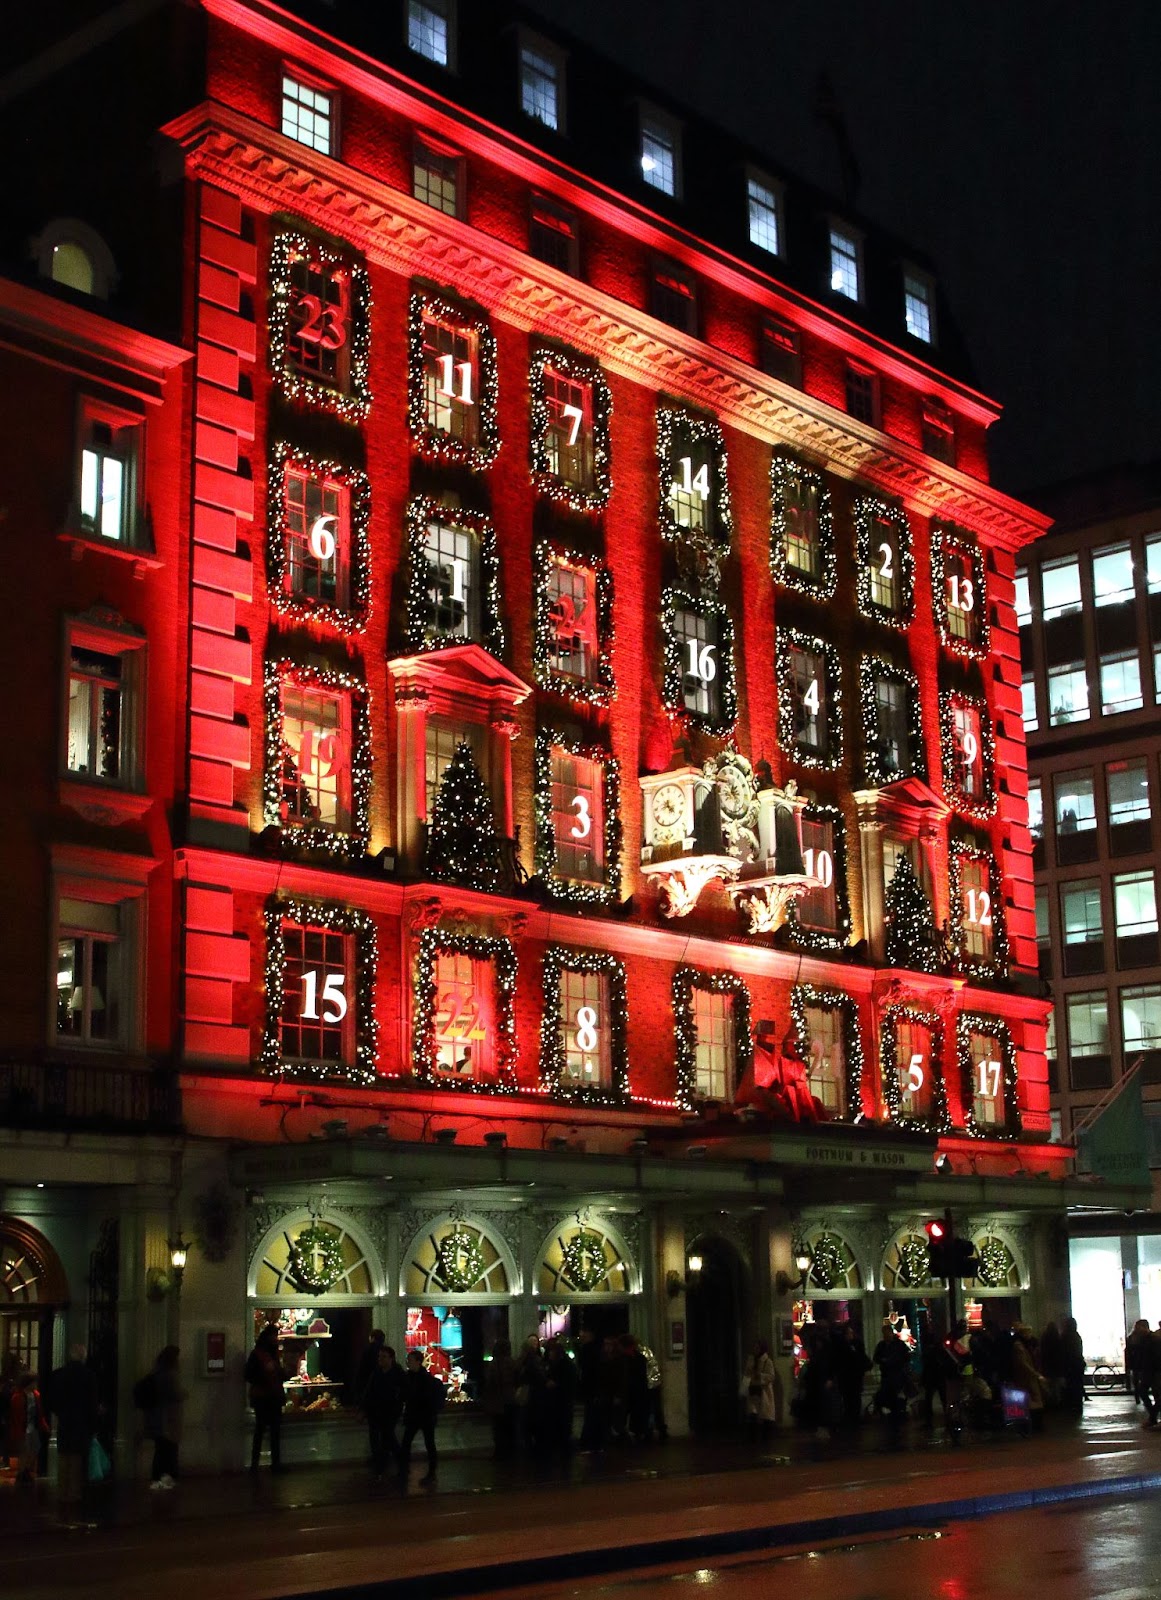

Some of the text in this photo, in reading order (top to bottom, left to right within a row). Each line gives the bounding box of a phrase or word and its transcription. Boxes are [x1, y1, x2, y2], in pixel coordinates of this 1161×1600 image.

[297, 296, 346, 351] 23
[438, 354, 475, 406] 11
[562, 403, 584, 446] 7
[678, 456, 710, 502] 14
[310, 514, 335, 561] 6
[448, 559, 467, 603] 1
[877, 542, 893, 579] 2
[948, 575, 975, 613] 13
[552, 593, 592, 645] 24
[686, 637, 716, 684] 16
[803, 679, 820, 716] 4
[294, 728, 345, 779] 19
[962, 731, 978, 766] 9
[570, 795, 591, 839] 3
[804, 847, 834, 889] 10
[965, 887, 994, 927] 12
[299, 970, 348, 1024] 15
[440, 991, 487, 1041] 22
[576, 1005, 598, 1054] 8
[907, 1053, 925, 1093] 5
[974, 1060, 1003, 1097] 17
[806, 1146, 853, 1162] FORTNUM
[873, 1152, 906, 1165] MASON
